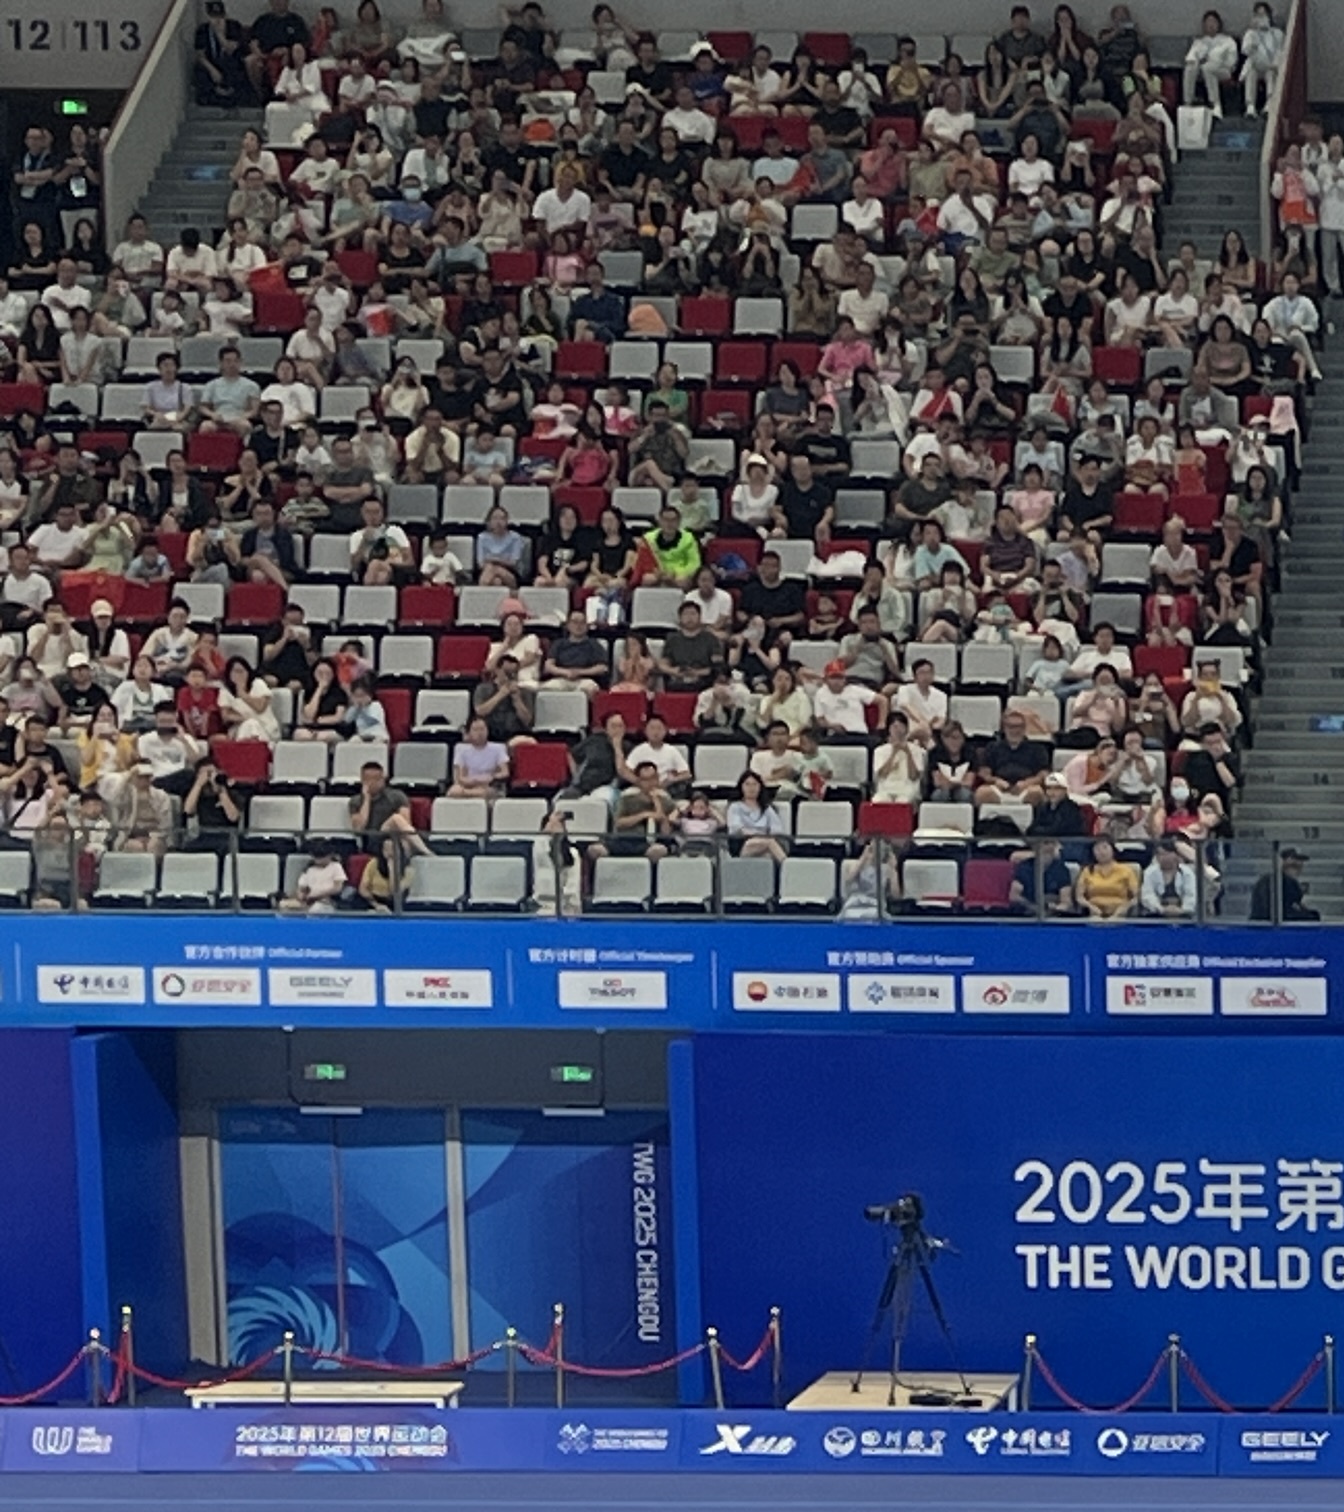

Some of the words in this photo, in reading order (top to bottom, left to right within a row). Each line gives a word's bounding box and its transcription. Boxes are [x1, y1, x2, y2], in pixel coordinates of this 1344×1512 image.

[73, 20, 141, 50] 113
[633, 1186, 658, 1246] 2025
[1015, 1244, 1113, 1289] THE
[1124, 1245, 1311, 1289] WORLD
[635, 1249, 660, 1343] CHENGDU
[1241, 1431, 1330, 1447] GEELY
